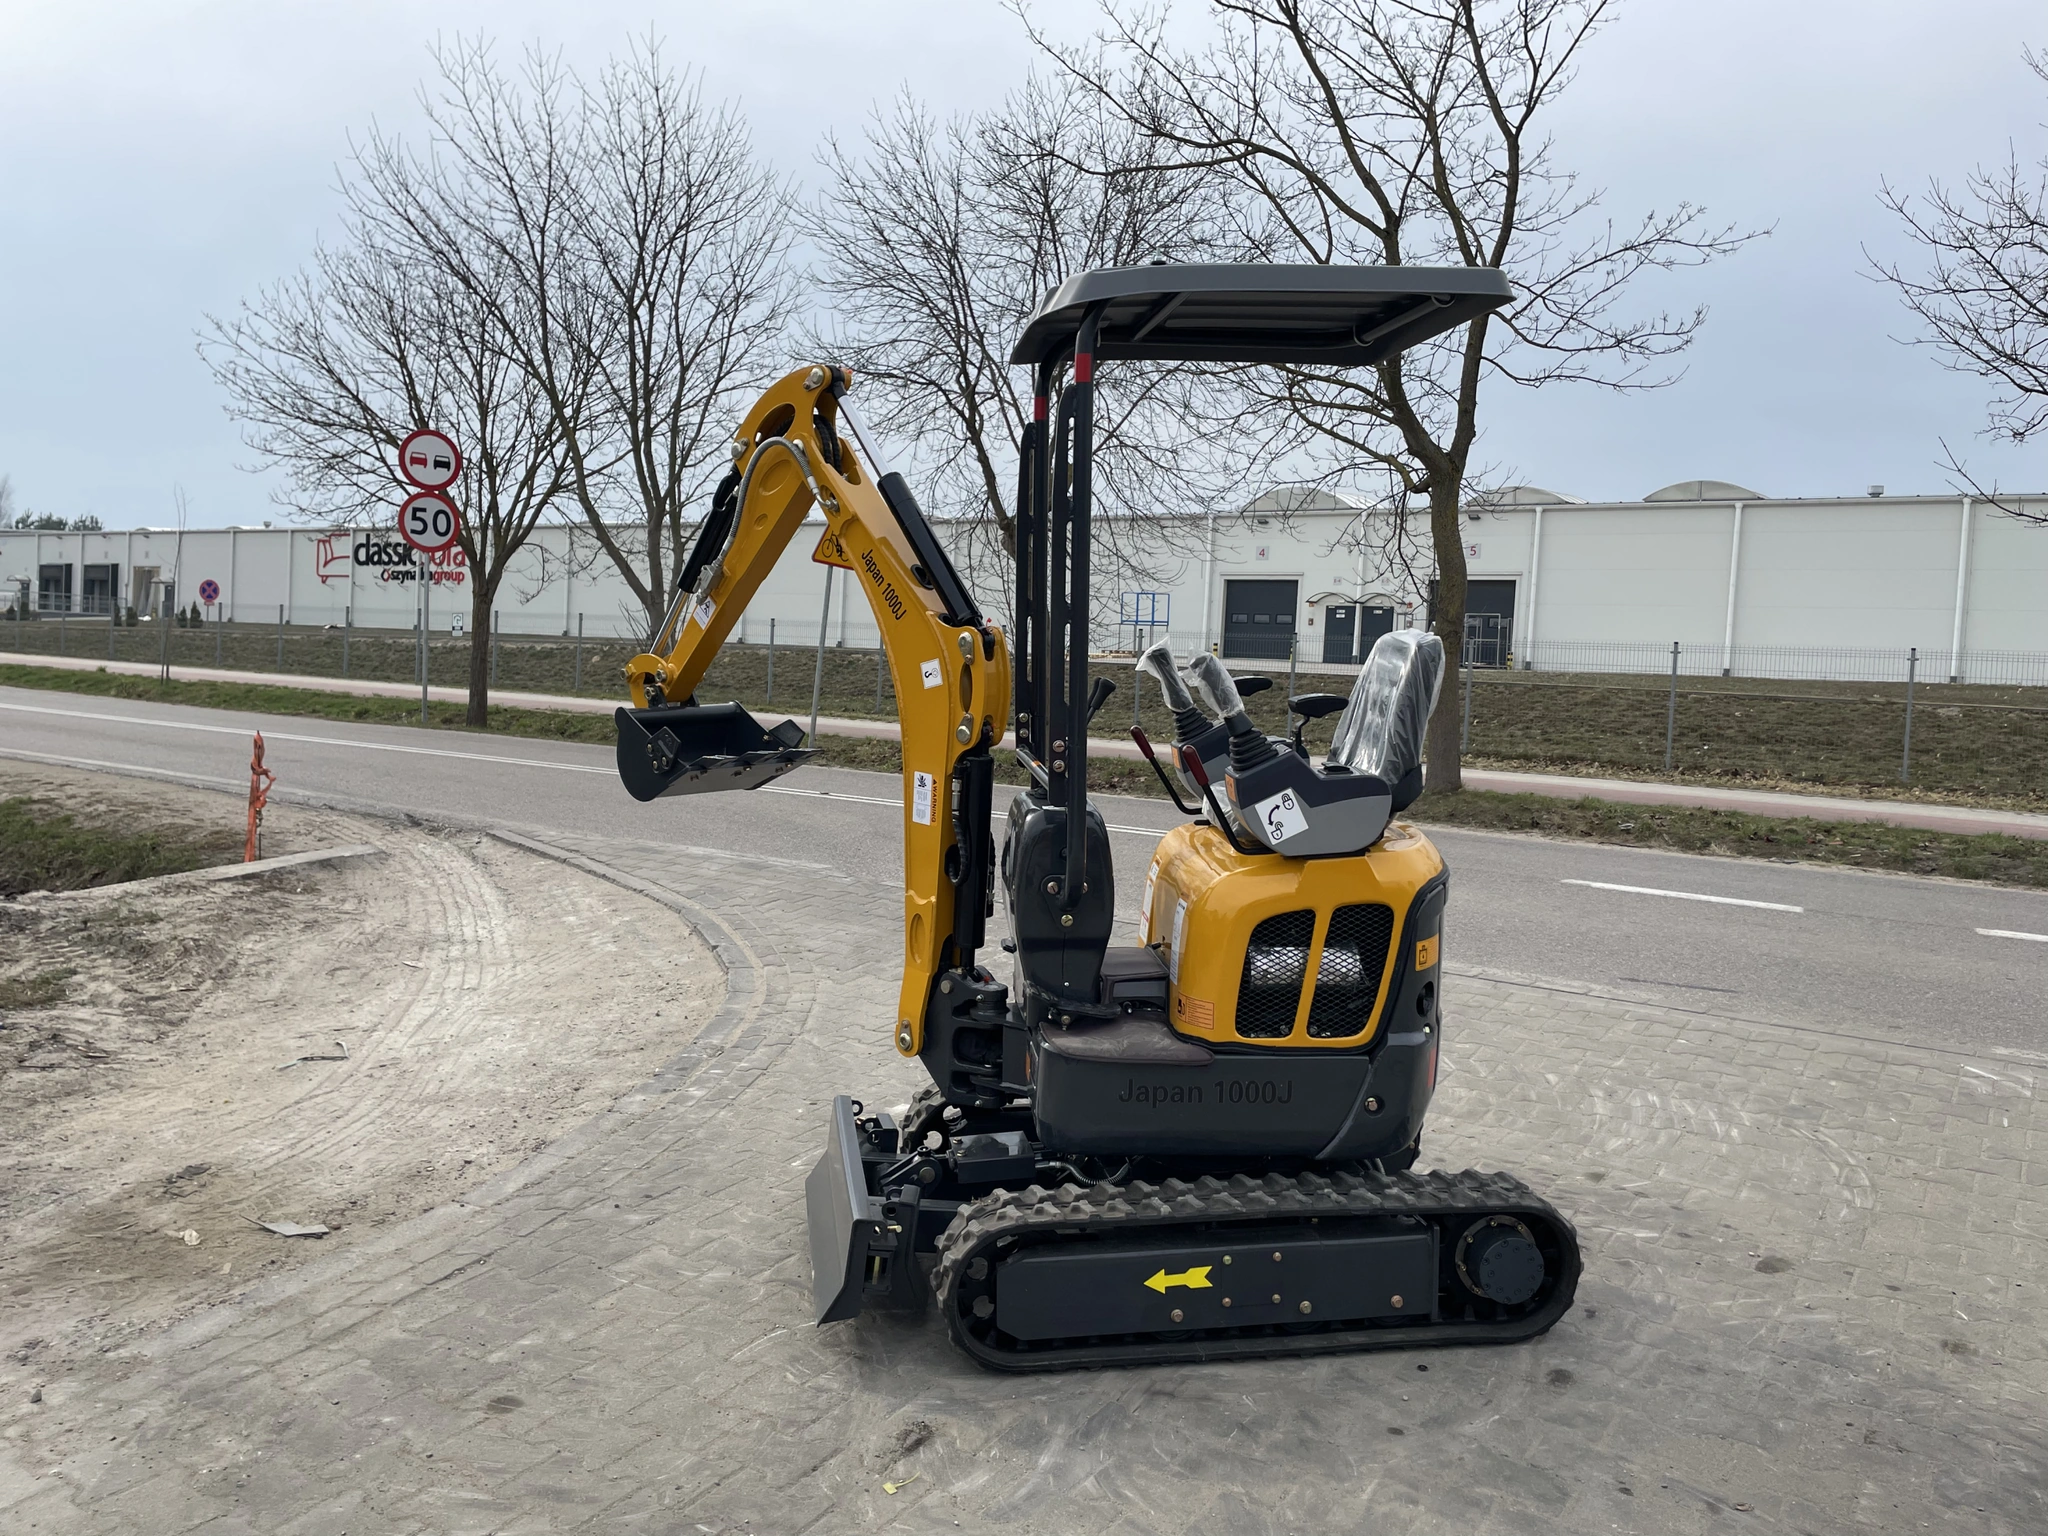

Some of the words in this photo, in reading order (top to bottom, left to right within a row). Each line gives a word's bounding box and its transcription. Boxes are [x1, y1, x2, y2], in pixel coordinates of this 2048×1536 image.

[409, 506, 452, 537] 50
[1258, 548, 1265, 558] 4
[1469, 545, 1477, 557] 5
[861, 548, 885, 587] Japan
[881, 582, 907, 620] 1000J
[1118, 1078, 1204, 1109] Japan
[1214, 1080, 1294, 1104] 1000J
